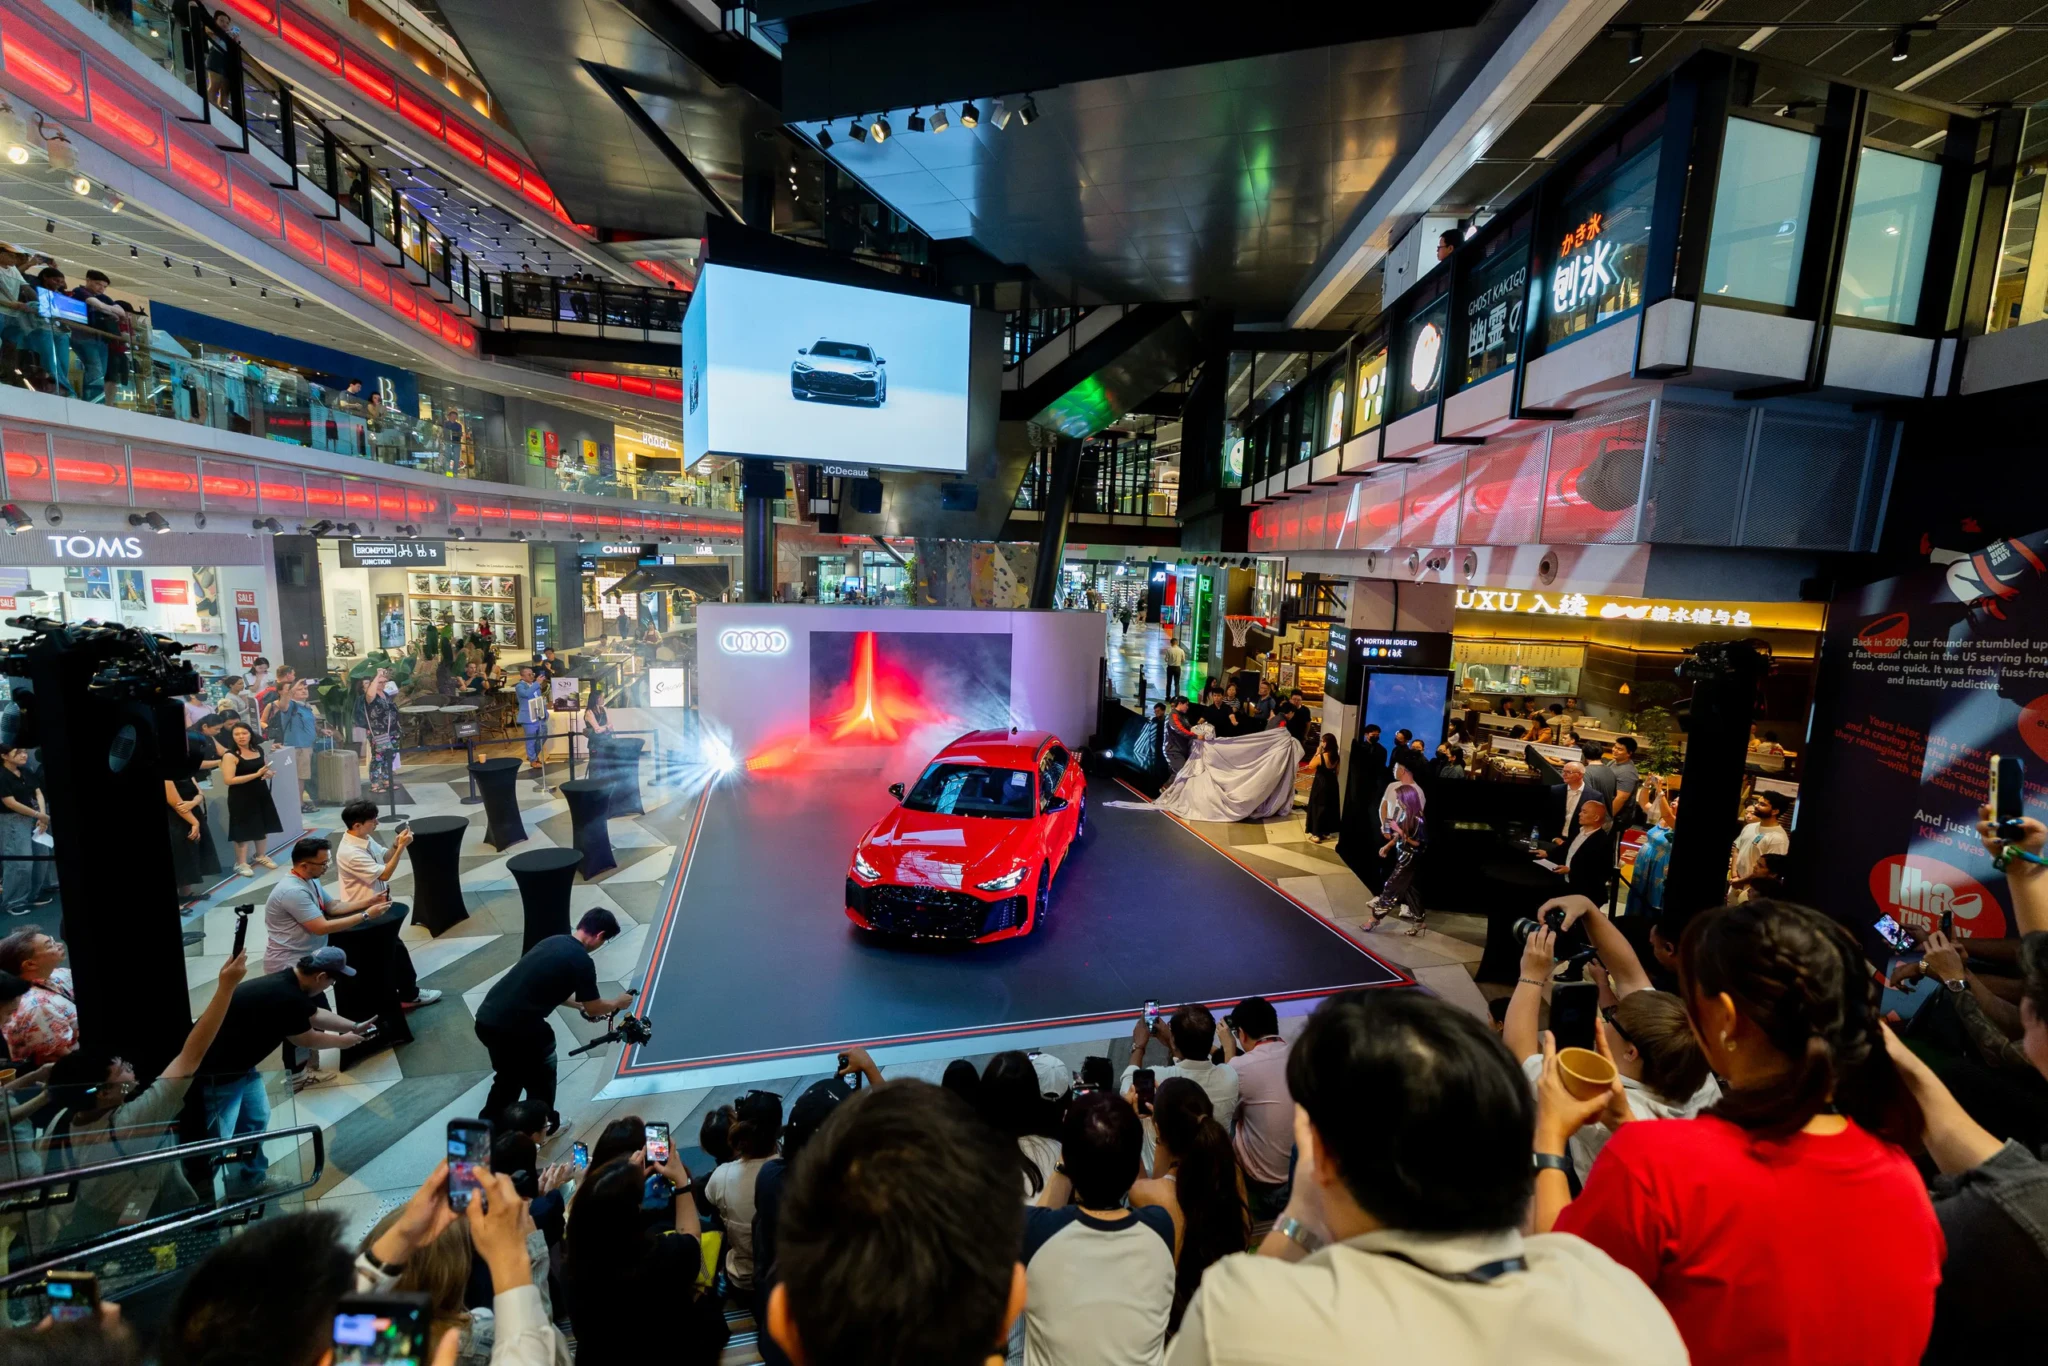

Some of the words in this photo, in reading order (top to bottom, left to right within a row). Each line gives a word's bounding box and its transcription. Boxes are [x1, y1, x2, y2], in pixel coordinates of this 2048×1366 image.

[1561, 213, 1602, 257] かき氷
[1468, 288, 1494, 316] GHOST
[1492, 266, 1526, 301] KAKIGO
[642, 431, 670, 450] HOOGA
[823, 465, 869, 477] JCDecaux
[48, 535, 143, 559] TOMS
[356, 546, 394, 554] BROMPTON
[1986, 538, 2004, 553] RICE
[1991, 550, 2011, 566] BABY
[237, 593, 253, 603] SALE
[1455, 589, 1522, 612] UXU
[239, 621, 261, 644] 70
[1852, 638, 1872, 647] Back
[1875, 638, 1883, 647] in
[1885, 638, 1910, 650] 2008,
[1932, 638, 1973, 649] founder
[1976, 639, 2029, 650] stumbled
[1855, 650, 1901, 659] fast-casual
[1903, 651, 1928, 661] chain
[1931, 652, 1939, 661] in
[1942, 652, 1959, 661] the
[1962, 653, 1977, 662] US
[1980, 655, 2021, 665] serving
[1852, 663, 1875, 672] food,
[1877, 663, 1900, 672] done
[1902, 664, 1931, 675] quick.
[1934, 665, 1942, 674] It
[1967, 666, 1998, 677] fresh,
[1887, 676, 1904, 685] and
[1906, 676, 1949, 689] instantly
[1951, 680, 2004, 691] addictive.
[1845, 721, 1863, 735] and
[1872, 731, 1907, 750] craving
[1909, 740, 1926, 754] for
[1928, 748, 1945, 760] the
[1869, 714, 1894, 731] Years
[1895, 724, 1921, 741] later,
[1924, 734, 1948, 748] with
[1950, 743, 1957, 751] a
[1960, 743, 1983, 759] few
[1834, 729, 1854, 743] they
[1855, 737, 1908, 761] reimagined
[1911, 750, 1928, 767] the
[1931, 762, 1990, 789] fast-casual
[1911, 770, 1924, 779] an
[1927, 774, 1956, 792] Asian
[1914, 809, 1942, 827] And
[1943, 818, 1971, 837] just
[1919, 825, 1953, 847] Khao
[1958, 842, 1985, 857] was
[1899, 908, 1932, 932] THIS
